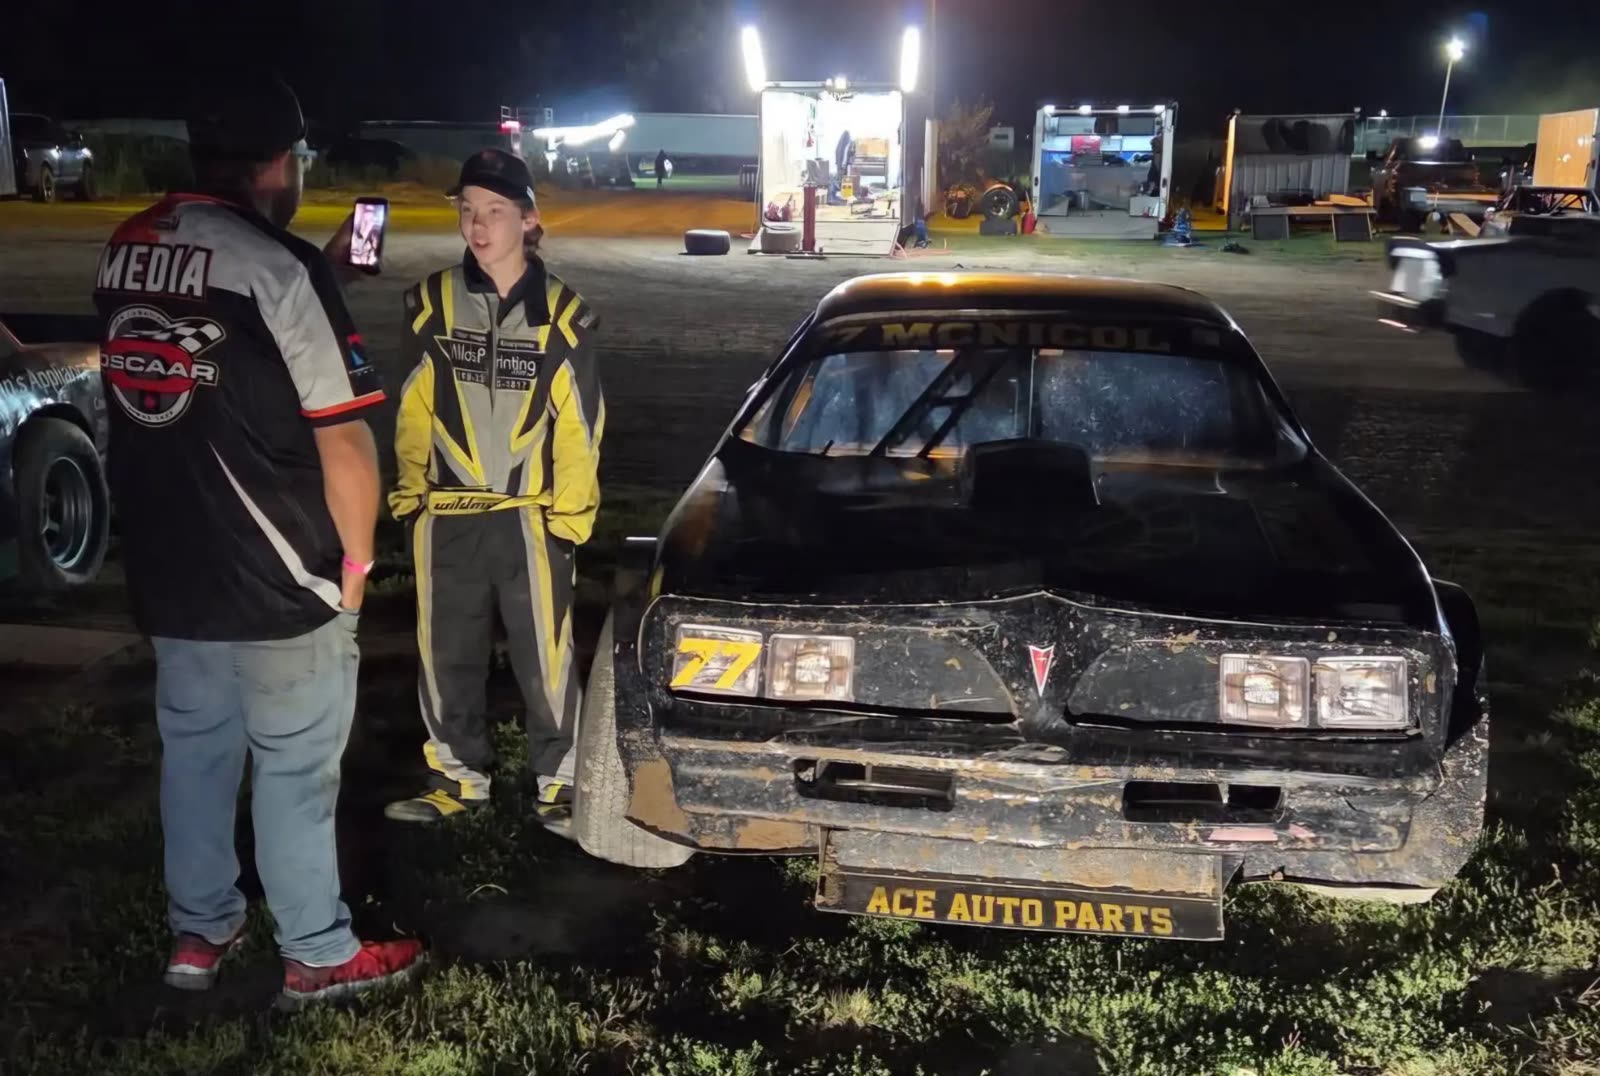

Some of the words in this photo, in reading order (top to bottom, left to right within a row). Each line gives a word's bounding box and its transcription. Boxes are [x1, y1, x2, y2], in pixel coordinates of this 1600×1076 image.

[97, 243, 208, 297] MEDIA
[881, 322, 1170, 350] MCNICOL
[100, 353, 216, 381] OSCAAR
[670, 637, 763, 689] 77
[866, 886, 936, 919] ACE
[947, 893, 1043, 927] AUTO
[1055, 900, 1174, 935] PARTS
